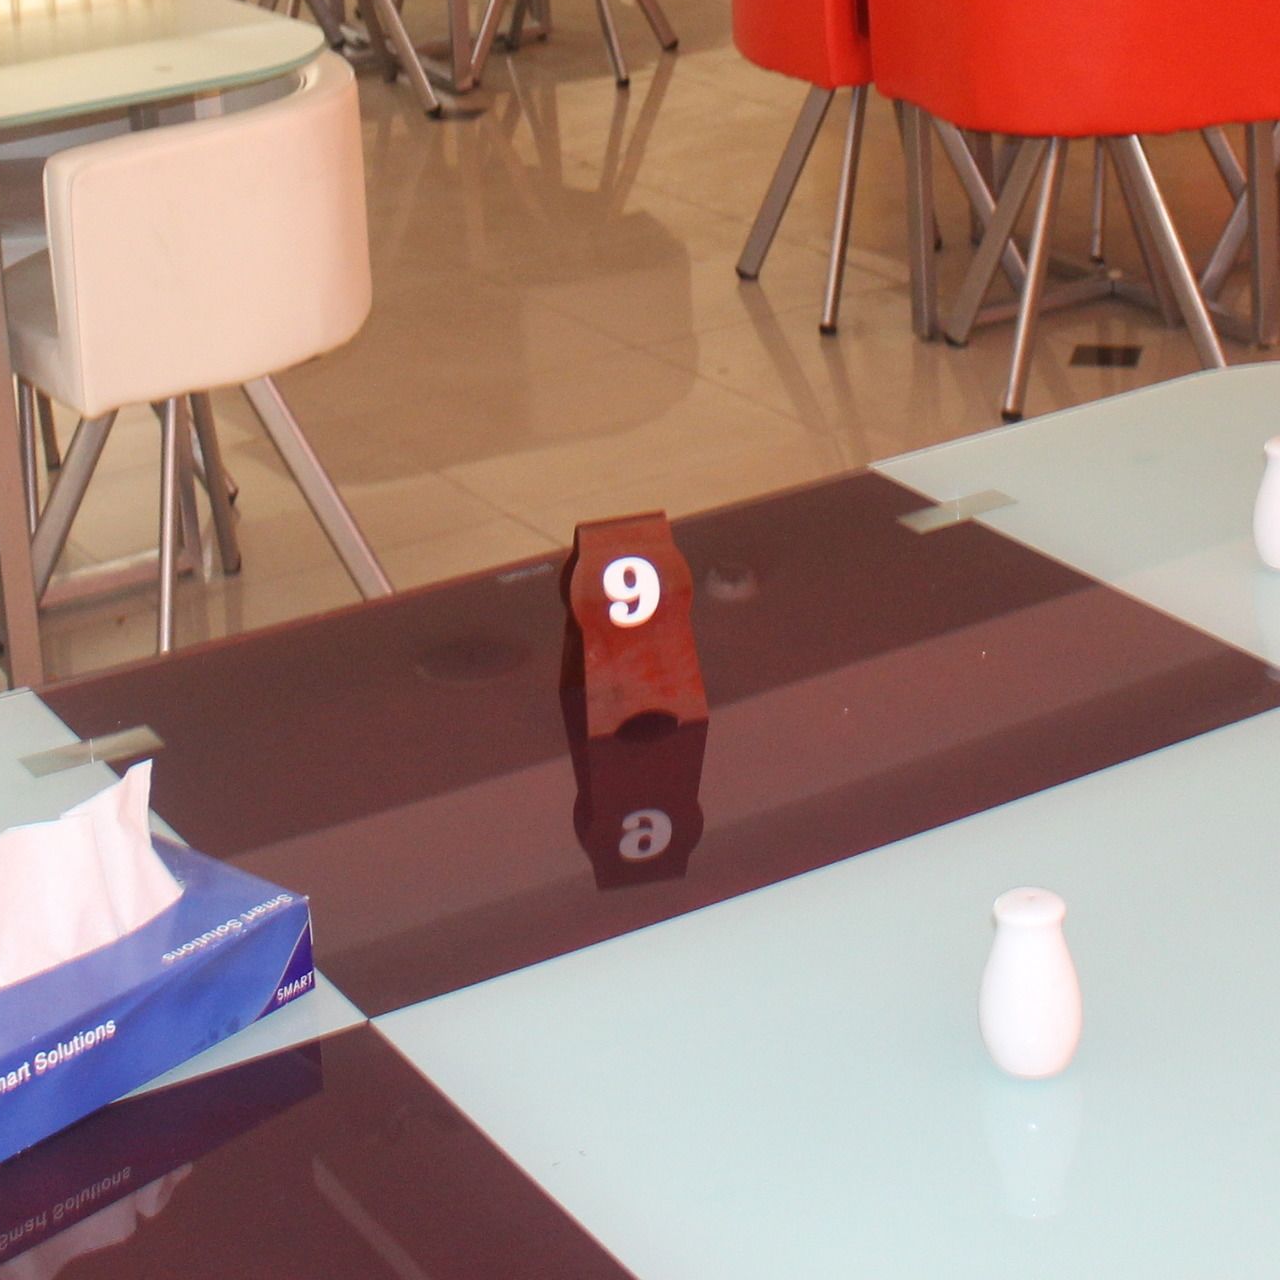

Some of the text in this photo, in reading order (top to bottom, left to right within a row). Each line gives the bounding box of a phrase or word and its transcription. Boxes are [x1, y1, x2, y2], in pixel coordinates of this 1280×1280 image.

[602, 555, 661, 628] 9
[161, 893, 294, 962] Smart Solutions
[276, 970, 314, 1001] SMART
[33, 1019, 117, 1072] Solutions
